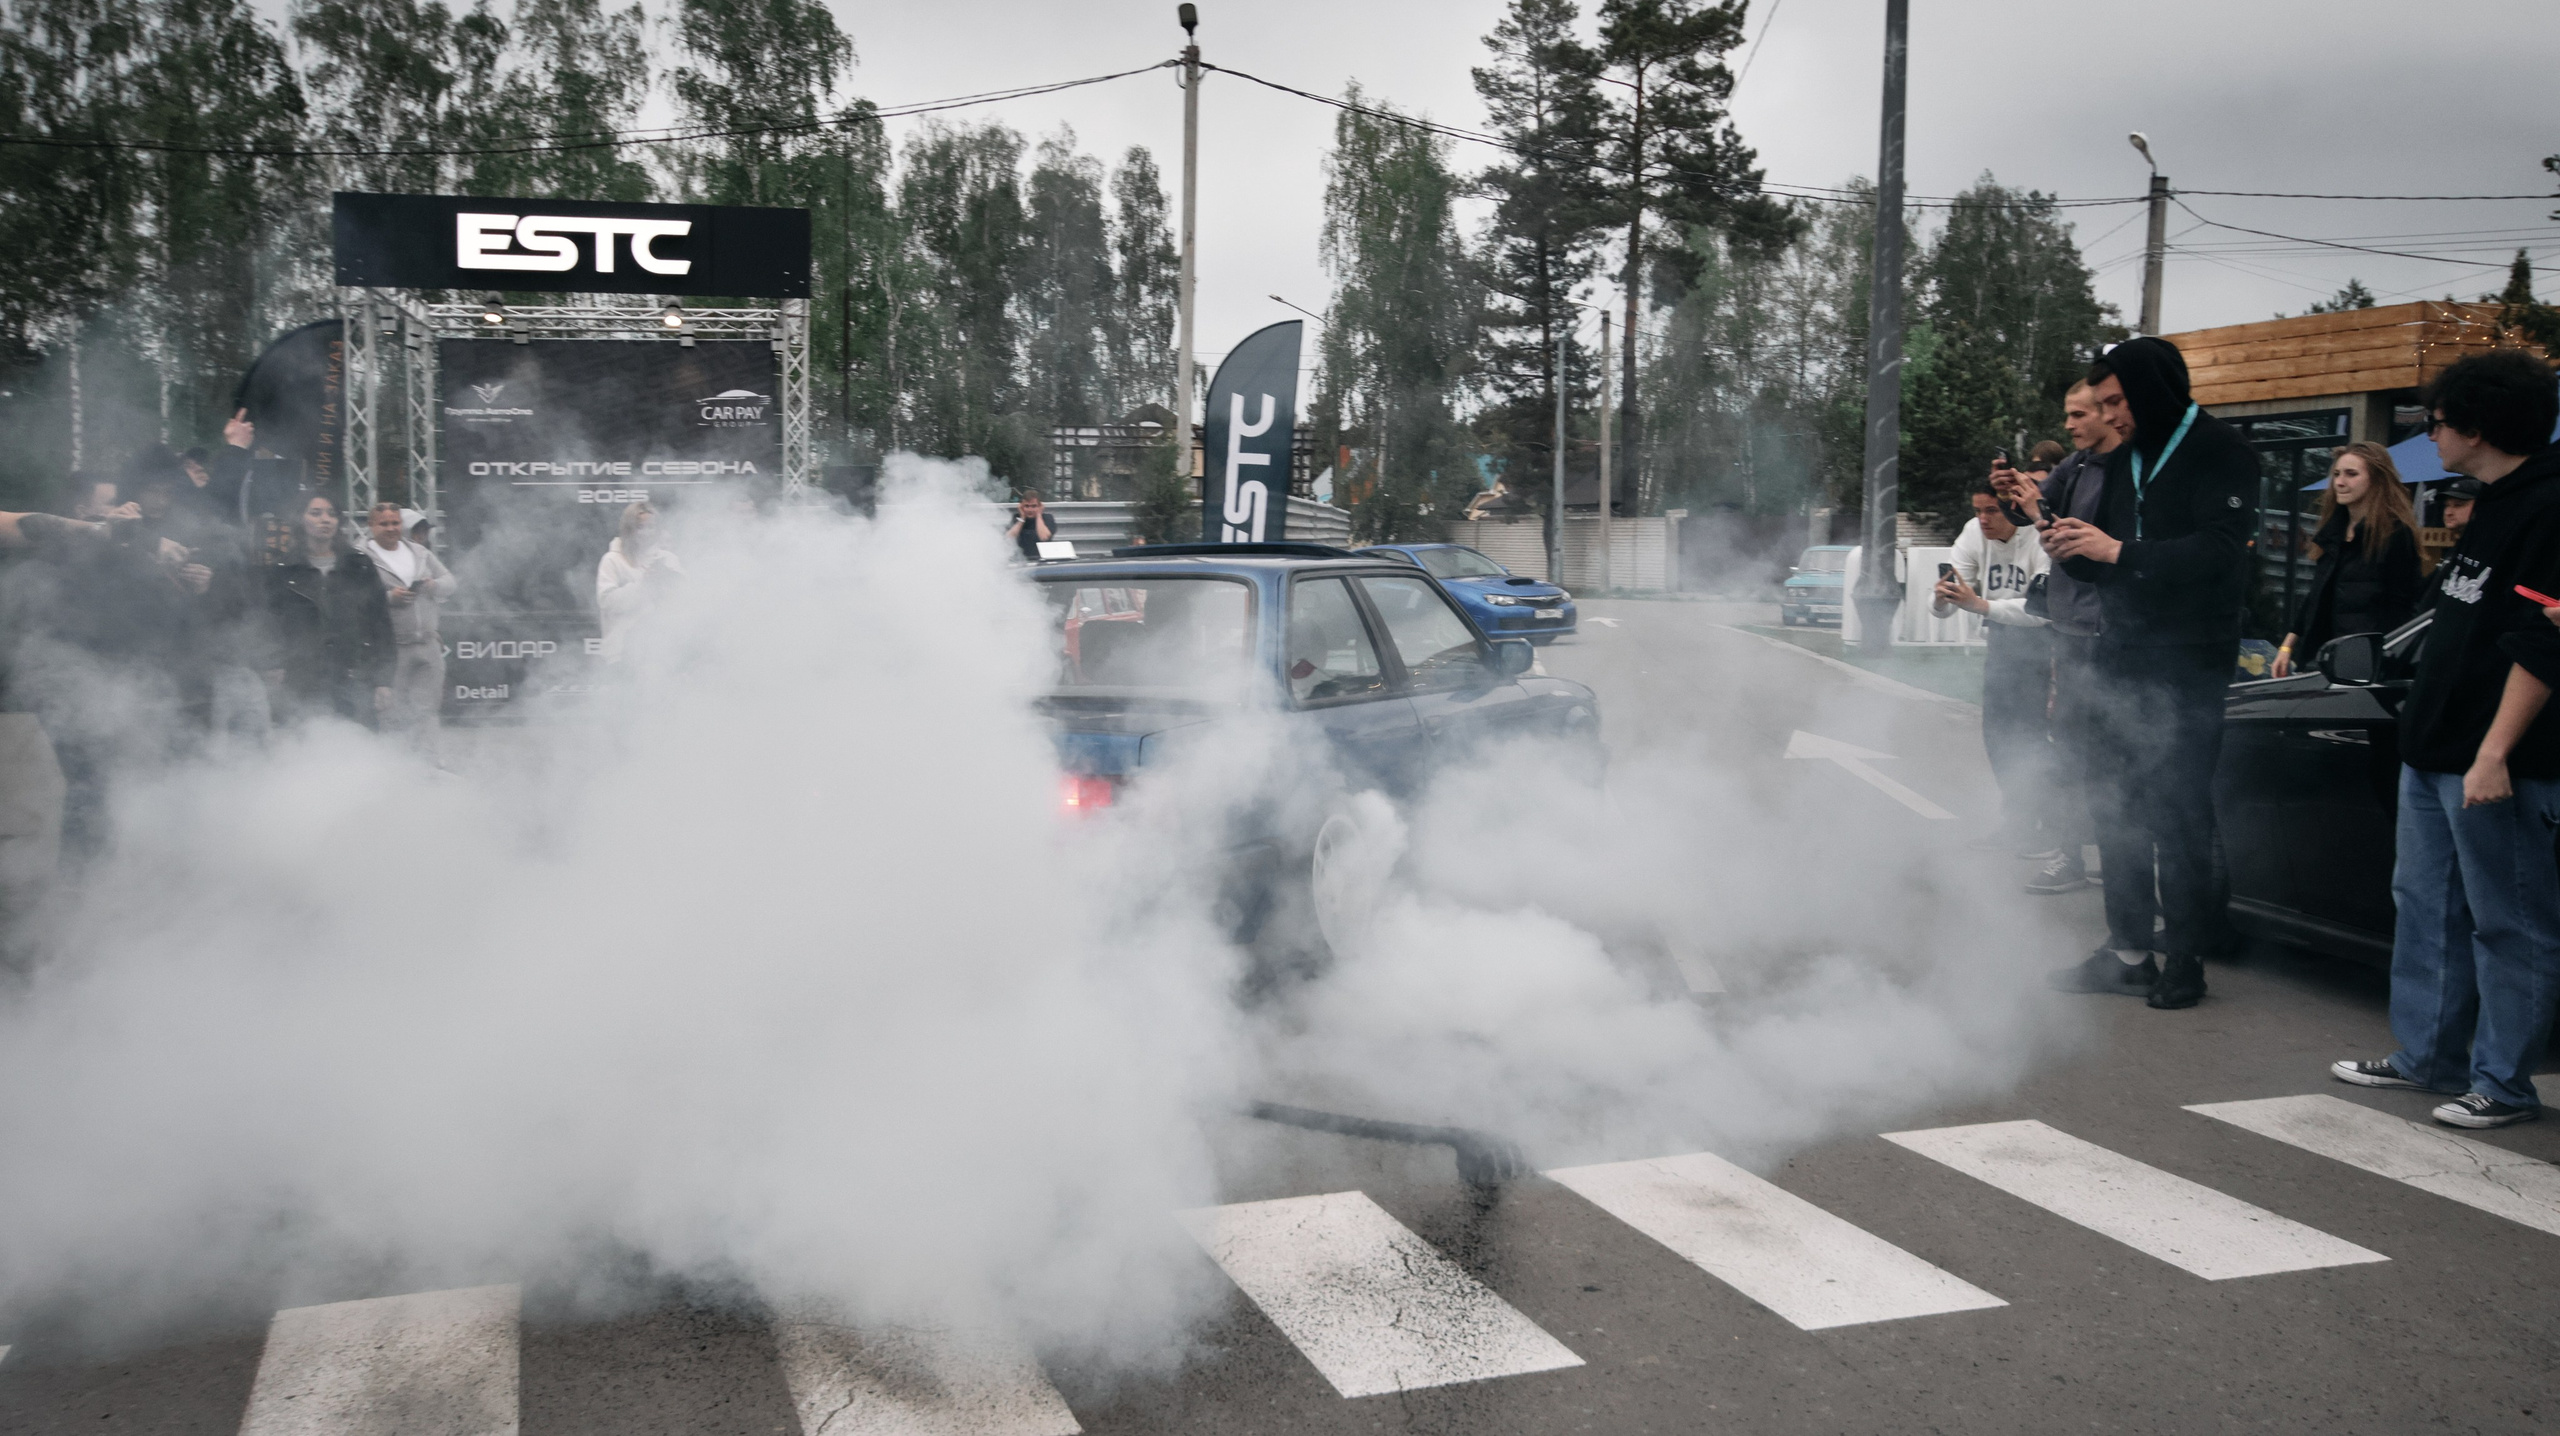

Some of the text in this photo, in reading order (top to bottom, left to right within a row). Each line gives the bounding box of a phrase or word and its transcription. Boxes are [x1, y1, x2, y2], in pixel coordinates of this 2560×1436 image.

[457, 212, 692, 275] ESTC
[324, 340, 344, 394] ЗАКАЗ
[320, 403, 337, 426] НА
[469, 461, 758, 476] ОТКРЫТИЕ СЕЗОНА
[578, 490, 649, 503] 2025
[1988, 564, 2027, 592] GAP
[456, 641, 557, 659] ВИДАР
[455, 684, 509, 699] Detail
